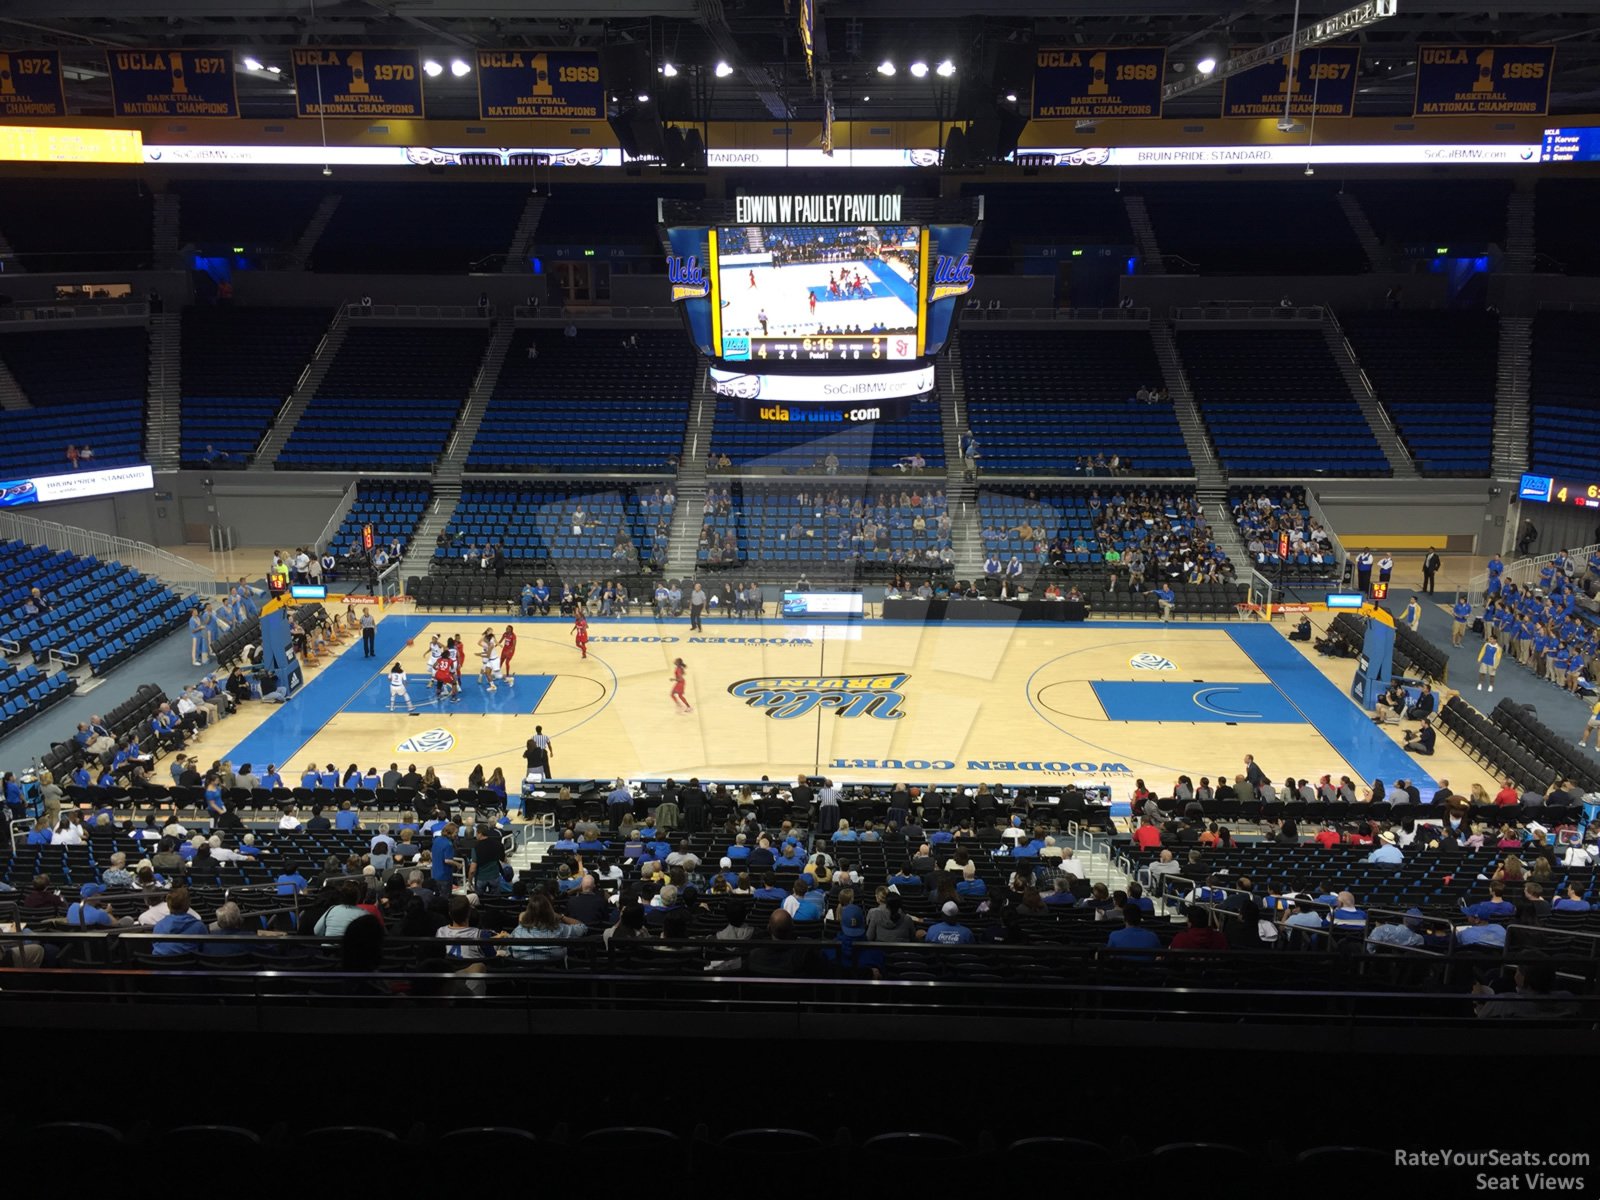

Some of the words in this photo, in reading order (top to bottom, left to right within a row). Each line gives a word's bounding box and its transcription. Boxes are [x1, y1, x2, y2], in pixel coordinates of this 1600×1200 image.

[117, 54, 166, 70] UCLA
[295, 50, 340, 66] UCLA
[480, 52, 524, 68] UCLA
[1037, 52, 1082, 67] UCLA
[1422, 49, 1468, 64] UCLA
[18, 59, 51, 74] 1972
[194, 58, 226, 73] 1971
[347, 52, 370, 93] 1
[1116, 65, 1157, 80] 1968
[1309, 63, 1350, 80] 1967
[1472, 49, 1495, 92] 1
[1502, 63, 1545, 79] 1965
[168, 52, 189, 94] 1
[374, 65, 414, 81] 1970
[531, 53, 553, 95] 1
[559, 66, 599, 82] 1969
[1088, 52, 1109, 94] 1
[146, 94, 204, 102] BASKETBALL
[334, 94, 384, 103] BASKETBALL
[517, 96, 567, 105] BASKETBALL
[1071, 95, 1122, 104] BASKETBALL
[1455, 92, 1507, 101] BASKETBALL
[6, 103, 56, 114] CHAMPIONS
[123, 103, 169, 114] NATIONAL
[176, 103, 228, 114] CHAMPIONS
[305, 104, 355, 114] NATIONAL
[357, 104, 414, 114] CHAMPIONS
[488, 106, 537, 116] NATIONAL
[539, 106, 596, 117] CHAMPIONS
[1040, 105, 1092, 116] NATIONAL
[1094, 105, 1152, 115] CHAMPIONS
[1231, 104, 1282, 113] NATIONAL
[1423, 102, 1476, 112] NATIONAL
[1478, 102, 1536, 112] CHAMPIONS
[708, 153, 762, 164] TANDARD.
[1138, 151, 1172, 161] BRUIN
[1424, 149, 1507, 159] SoCalBMW.com
[736, 196, 777, 223] EDWIN
[779, 196, 793, 222] W
[795, 196, 842, 222] PAULEY
[844, 194, 901, 222] PAVILION
[757, 343, 768, 359] 4
[803, 338, 834, 351] 6:16
[872, 343, 881, 359] 3
[1557, 487, 1568, 502] 4
[689, 636, 814, 645] WOODEN
[440, 660, 449, 669] 33
[756, 677, 898, 689] BRUINS
[829, 759, 956, 770] COURT
[967, 761, 1134, 773] WOODEN
